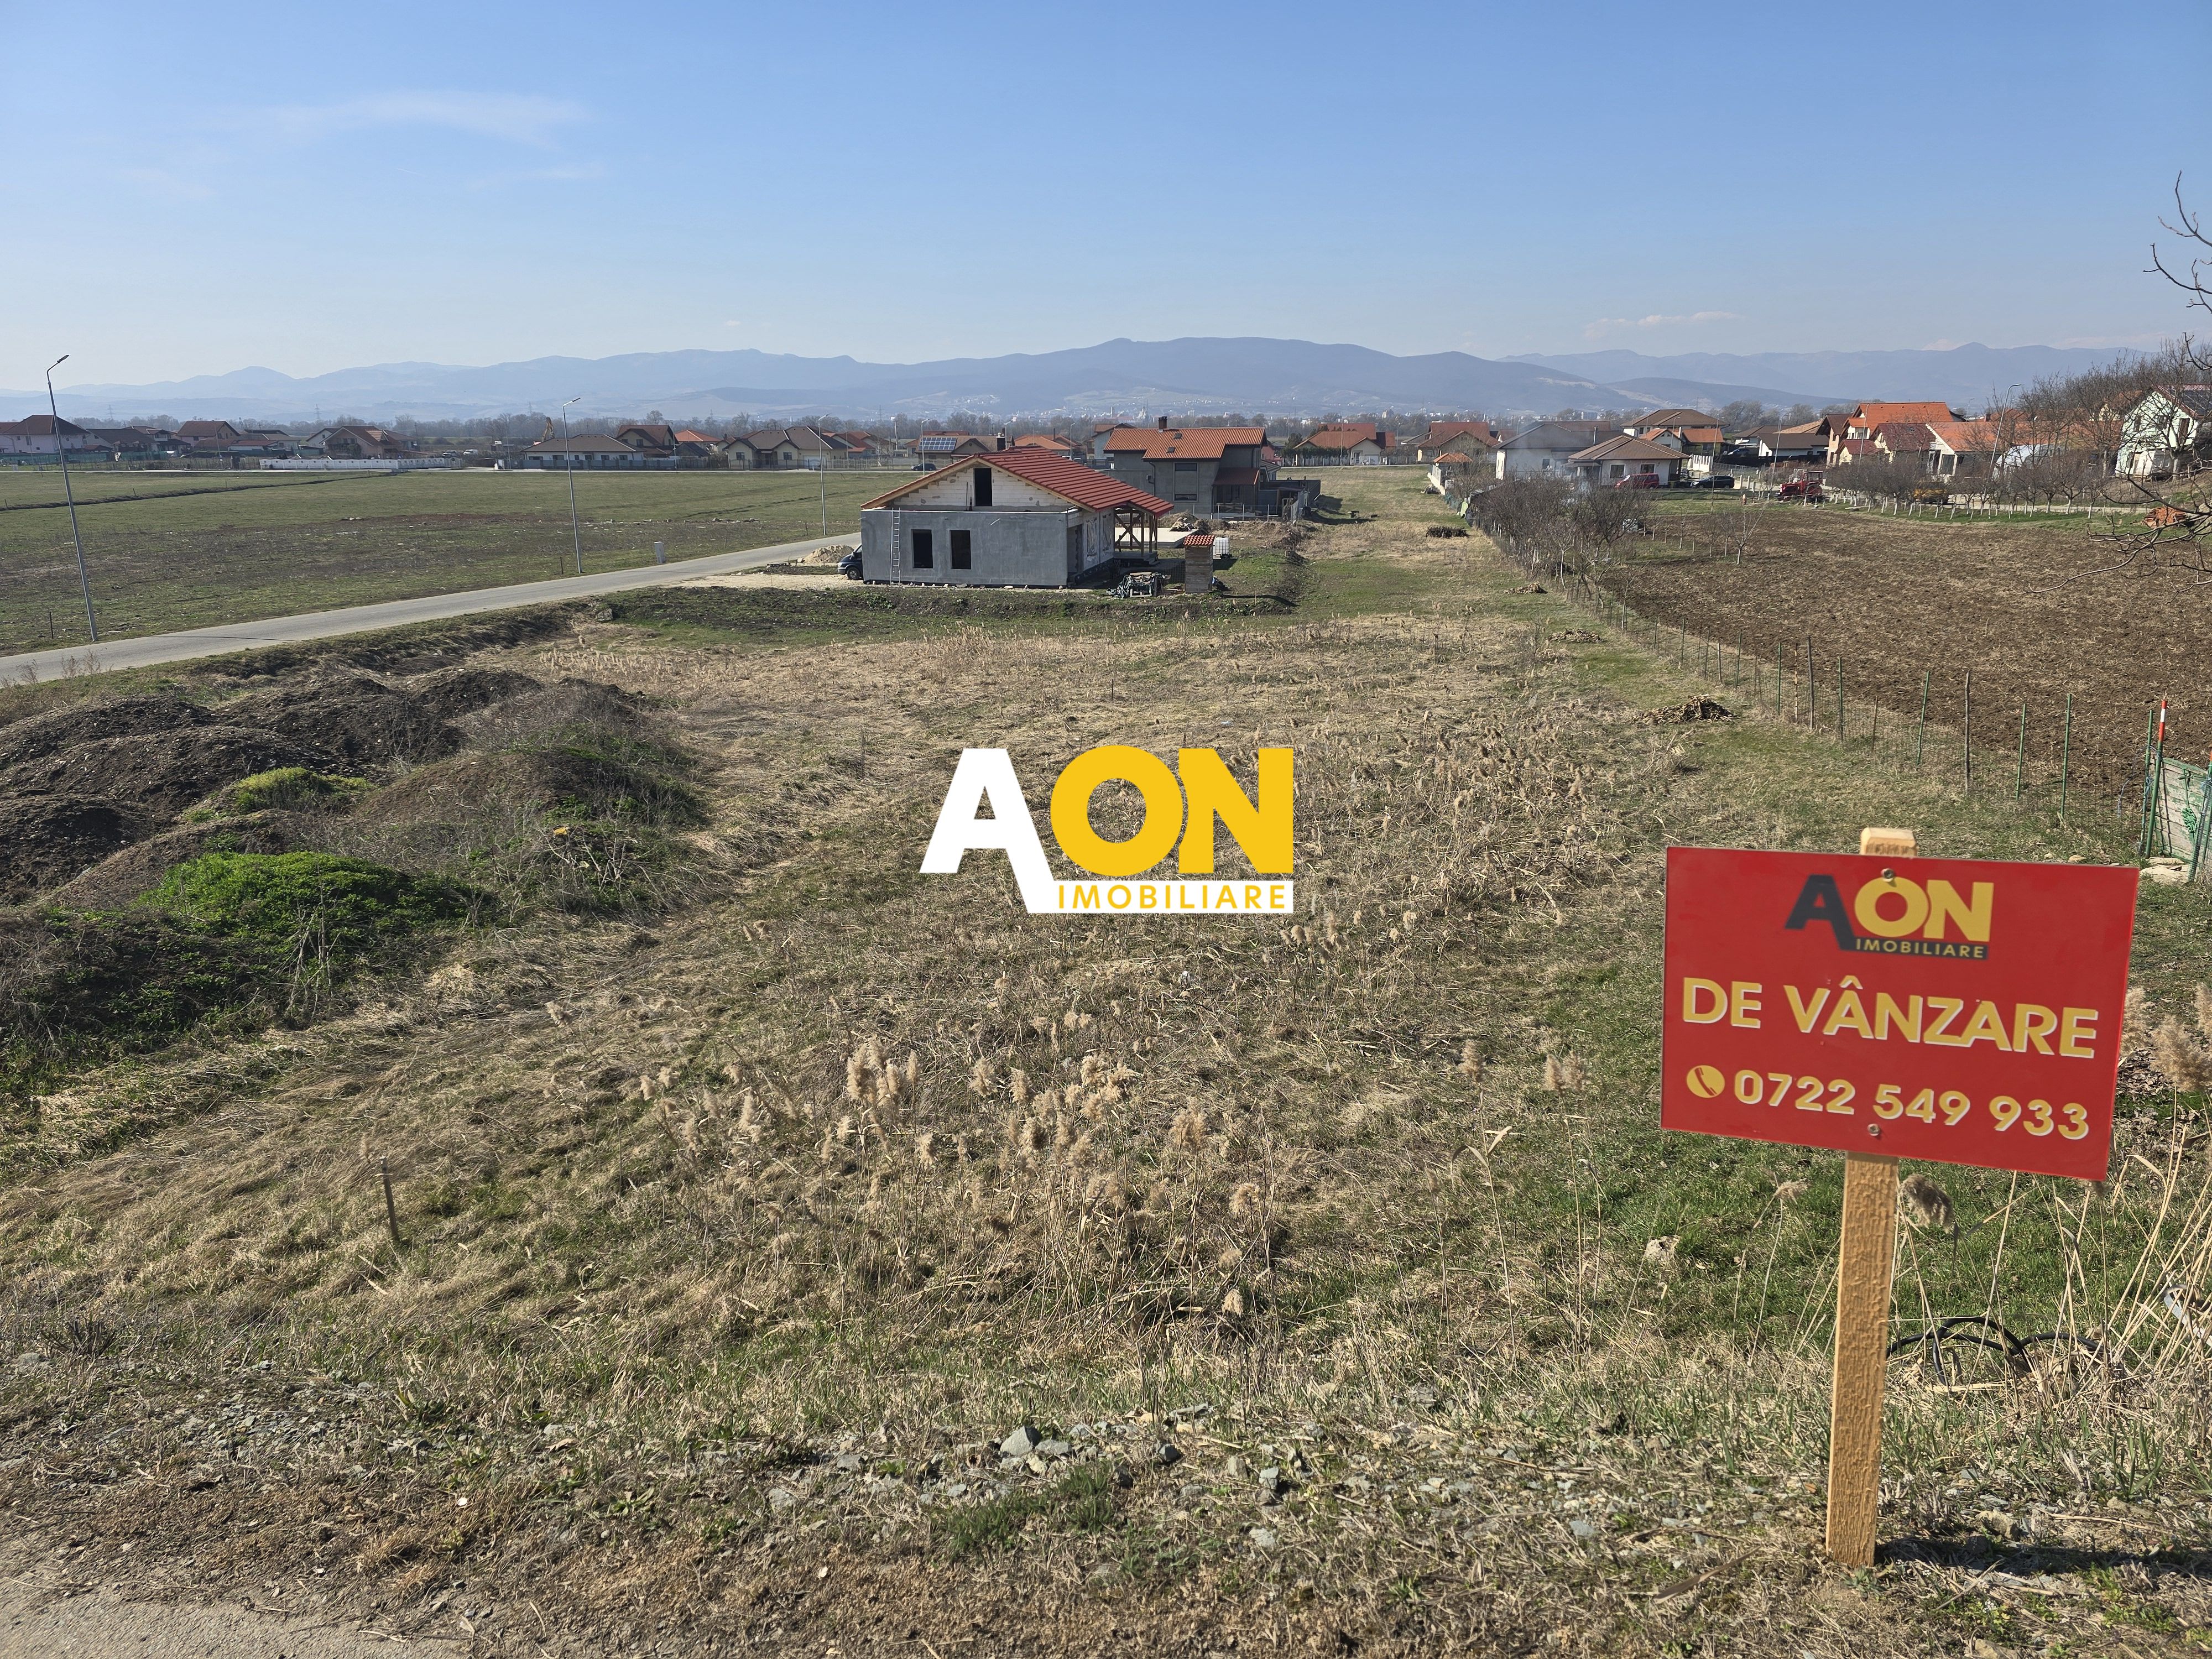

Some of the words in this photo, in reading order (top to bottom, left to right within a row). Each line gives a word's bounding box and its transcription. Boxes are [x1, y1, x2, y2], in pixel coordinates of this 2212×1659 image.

[1786, 874, 1994, 950] AON
[1856, 938, 1985, 958] IMOBILIARE
[1683, 977, 1762, 1029] DE
[1784, 975, 2099, 1058] VÂNZARE
[1734, 1070, 1855, 1115] 0722
[1872, 1084, 1970, 1125] 549
[1989, 1096, 2089, 1140] 933
